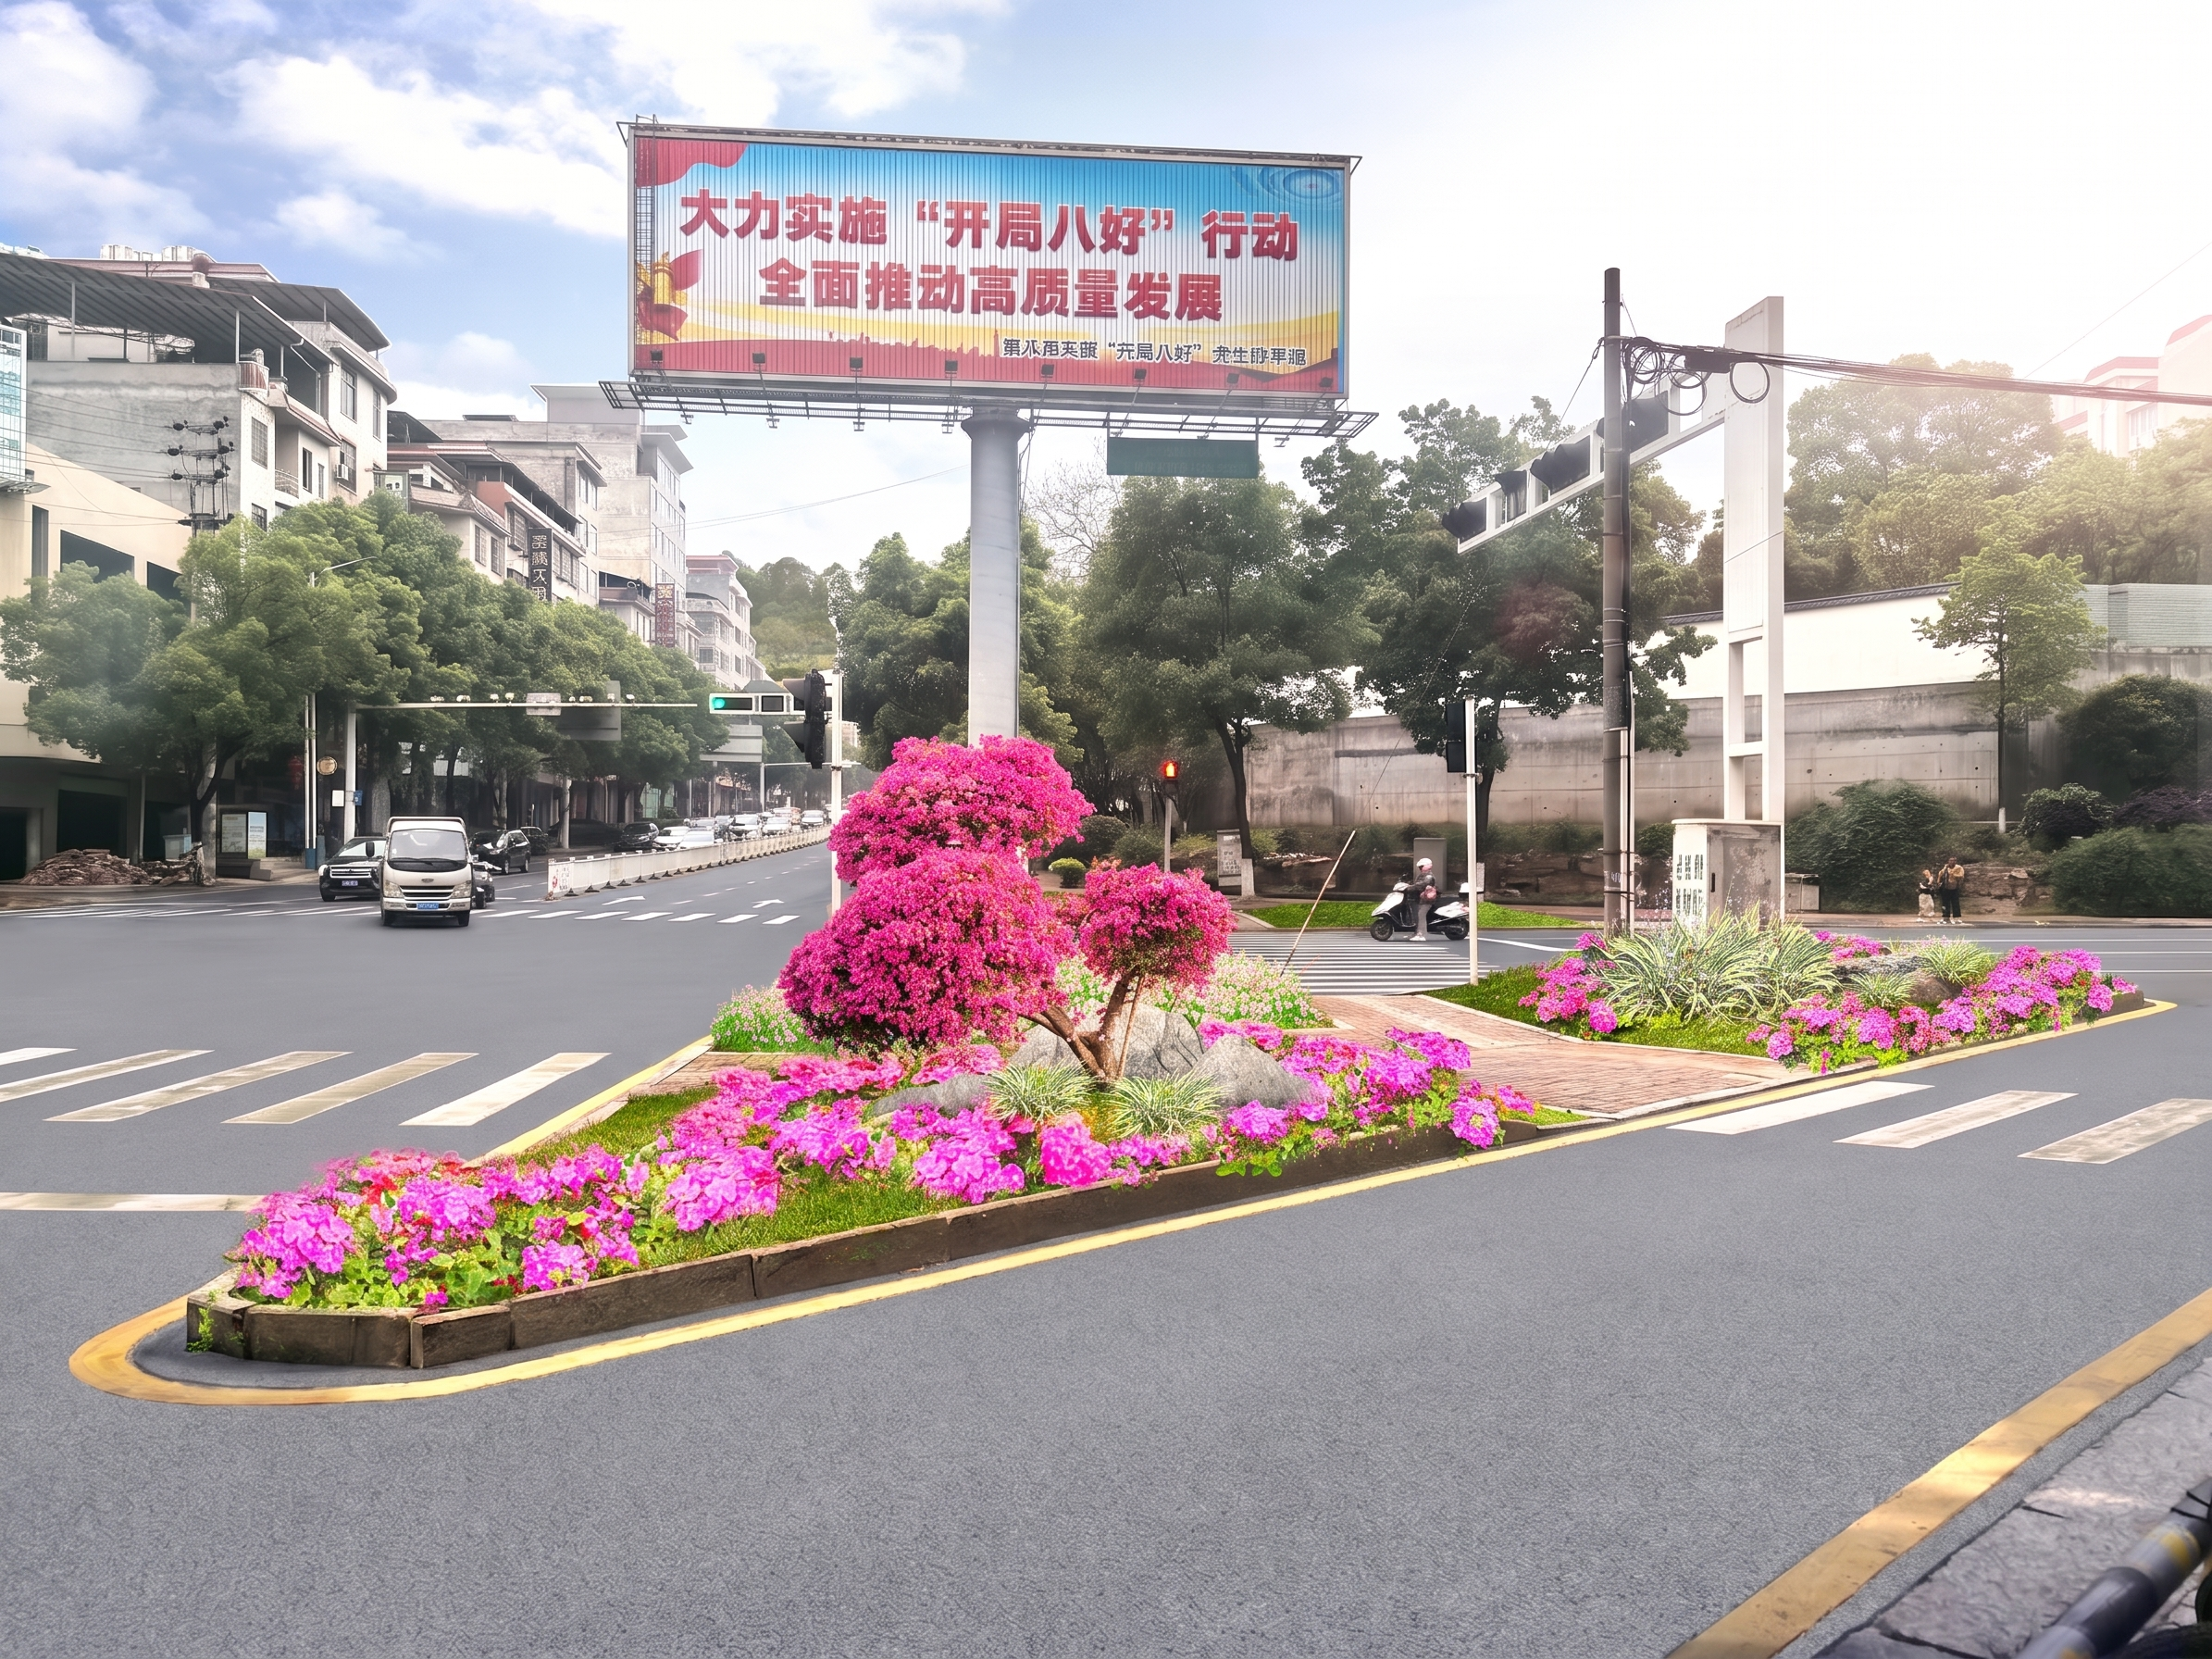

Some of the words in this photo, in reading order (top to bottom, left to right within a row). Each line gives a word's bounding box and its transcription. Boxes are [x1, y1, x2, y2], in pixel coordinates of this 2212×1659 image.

[679, 188, 888, 245] 大力实施
[916, 198, 1174, 256] “开局八好”
[1201, 209, 1299, 261] 行动
[758, 256, 1223, 322] 全面推动高质量发展
